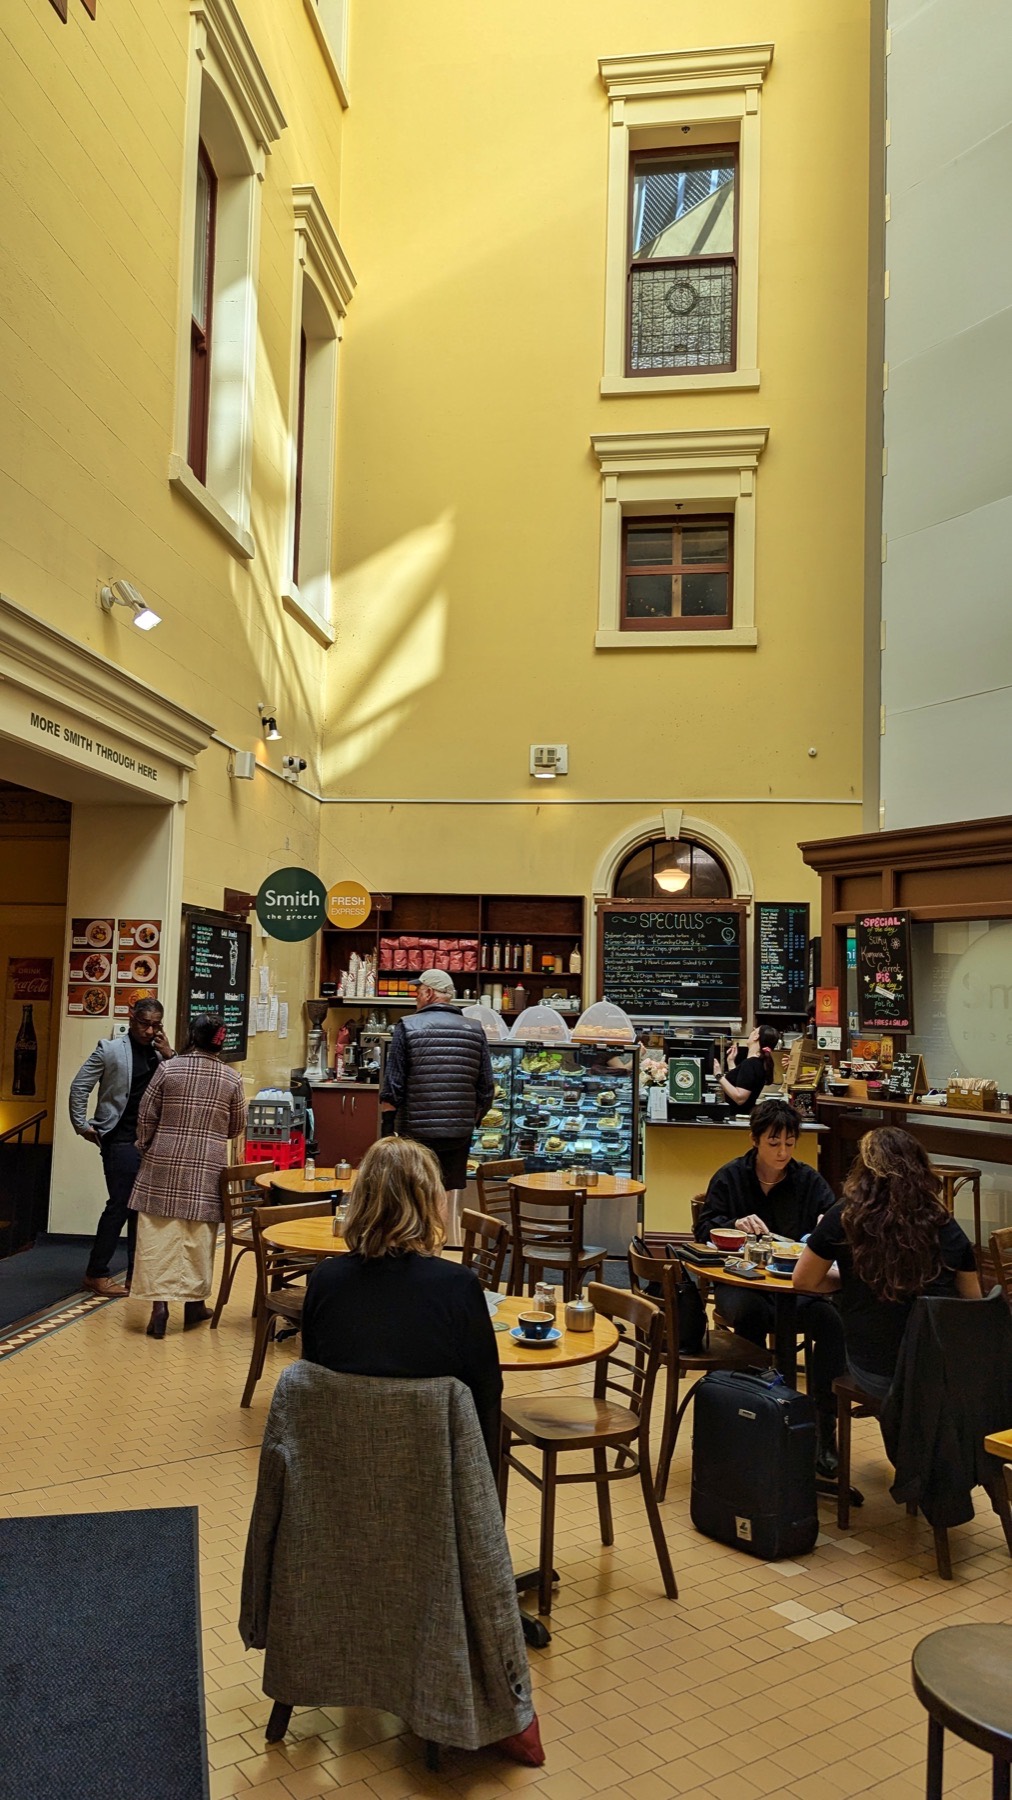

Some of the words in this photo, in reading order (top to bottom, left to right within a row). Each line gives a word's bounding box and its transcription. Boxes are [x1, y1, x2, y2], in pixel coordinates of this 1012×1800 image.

[30, 712, 60, 738] MORE
[63, 728, 92, 752] SMITH
[96, 742, 136, 771] THROUGH
[137, 762, 158, 781] HERE
[265, 890, 320, 906] Smith
[331, 896, 366, 906] FRESH
[331, 908, 366, 916] EXPRESS
[884, 926, 898, 936] day
[877, 962, 904, 973] Carrot
[850, 1019, 856, 1028] 4
